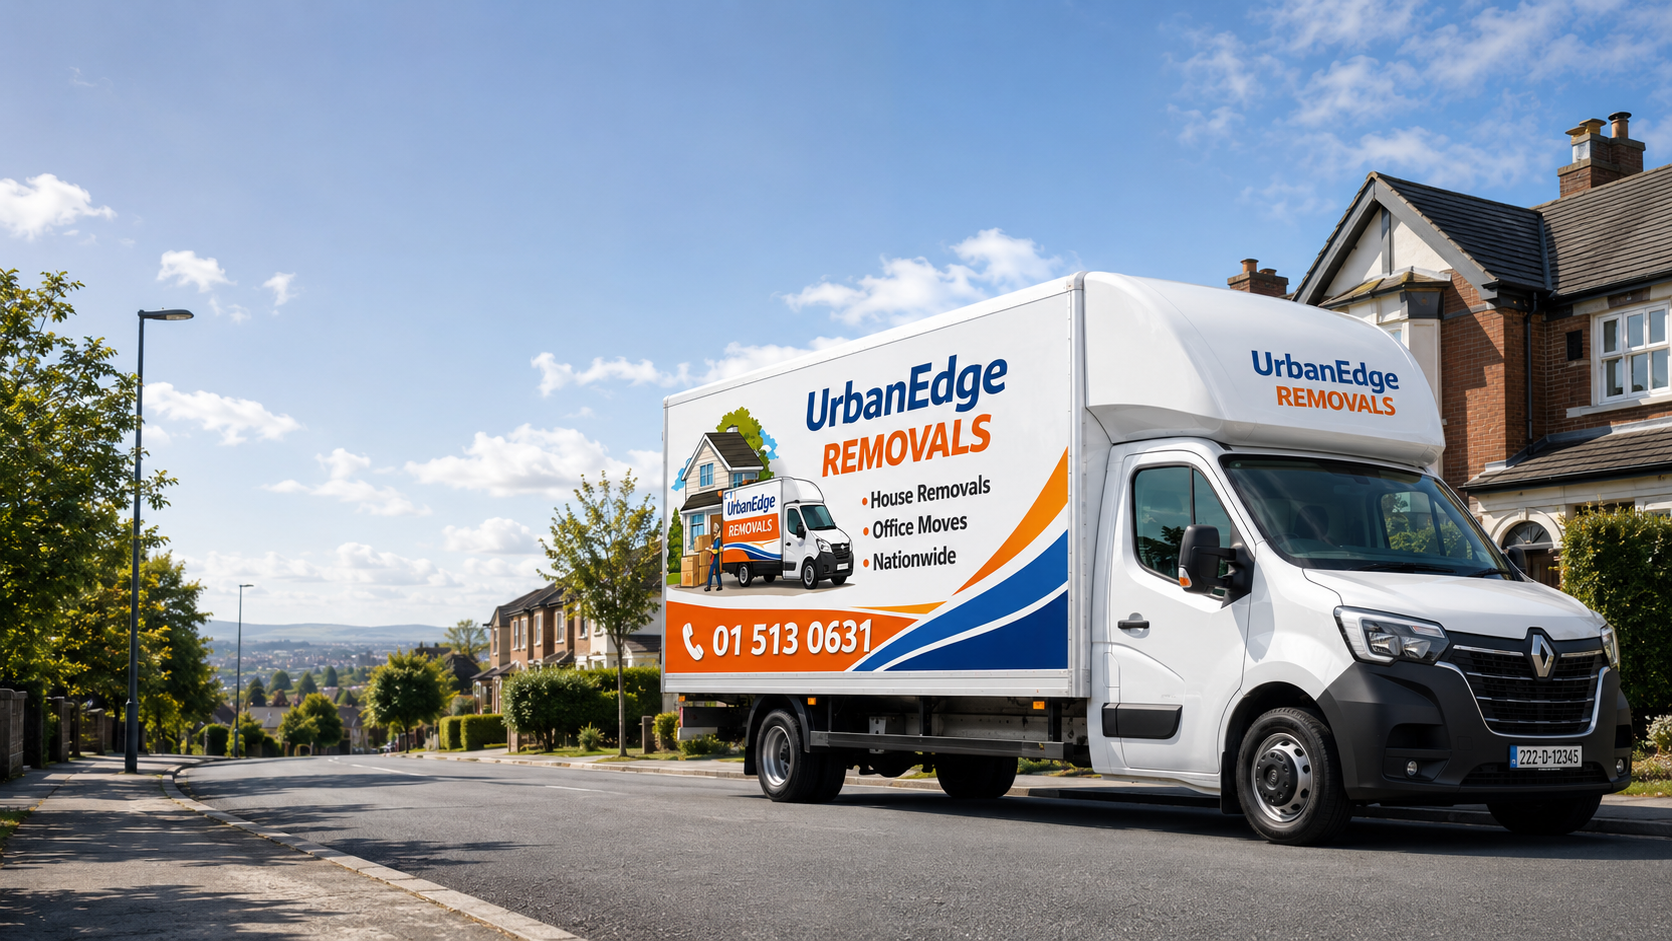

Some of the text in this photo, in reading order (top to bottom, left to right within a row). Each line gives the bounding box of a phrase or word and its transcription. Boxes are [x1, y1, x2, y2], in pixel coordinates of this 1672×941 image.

[1251, 350, 1400, 395] UrbanEdge
[805, 354, 1008, 432] UrbanEdge
[1276, 385, 1396, 416] REMOVALS
[821, 413, 992, 478] REMOVALS
[727, 493, 776, 516] UrbanEdge
[870, 475, 991, 509] House Removals
[728, 518, 773, 537] REMOVALS
[872, 514, 968, 539] Office Moves
[873, 545, 957, 571] Nationwide
[712, 618, 873, 657] 01 513 0631
[1519, 749, 1579, 765] 222-D-12345
